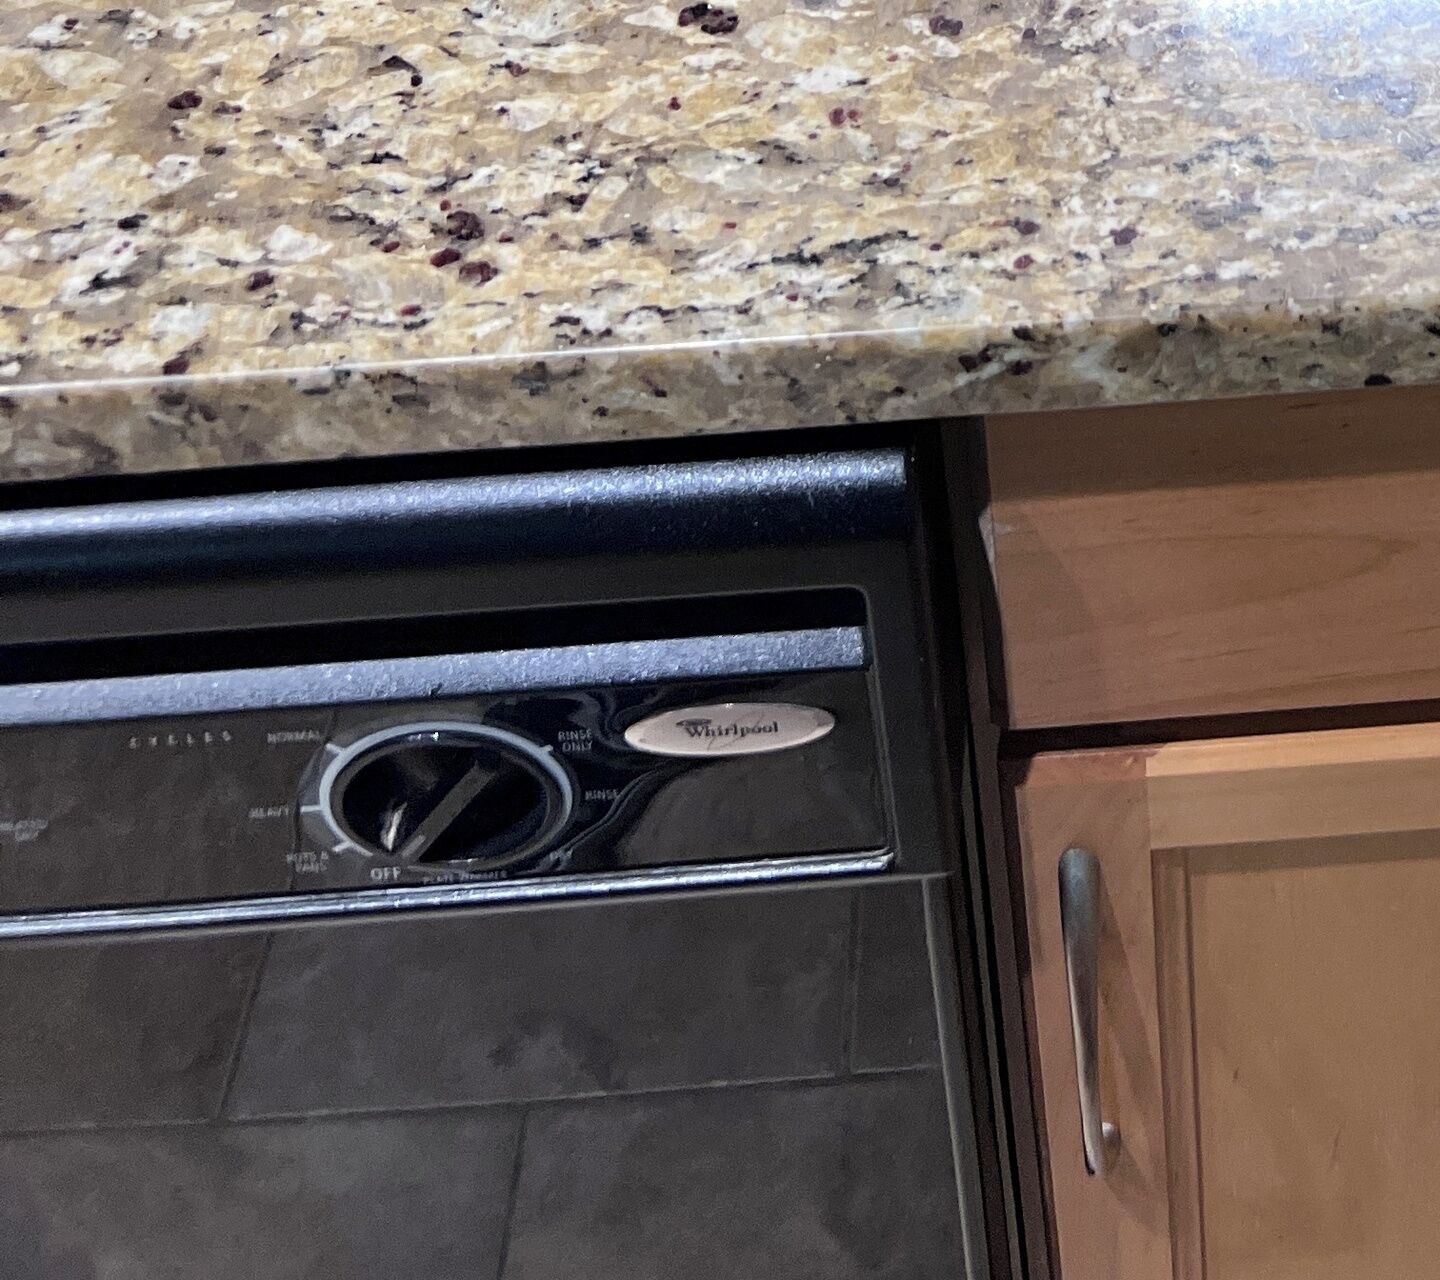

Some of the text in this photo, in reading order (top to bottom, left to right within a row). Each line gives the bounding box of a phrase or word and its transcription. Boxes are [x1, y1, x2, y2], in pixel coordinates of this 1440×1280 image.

[558, 729, 592, 741] RINSE
[684, 720, 779, 738] Whirlpool
[267, 730, 321, 744] NORMAL
[562, 740, 593, 752] ONLY
[370, 867, 401, 881] OFF
